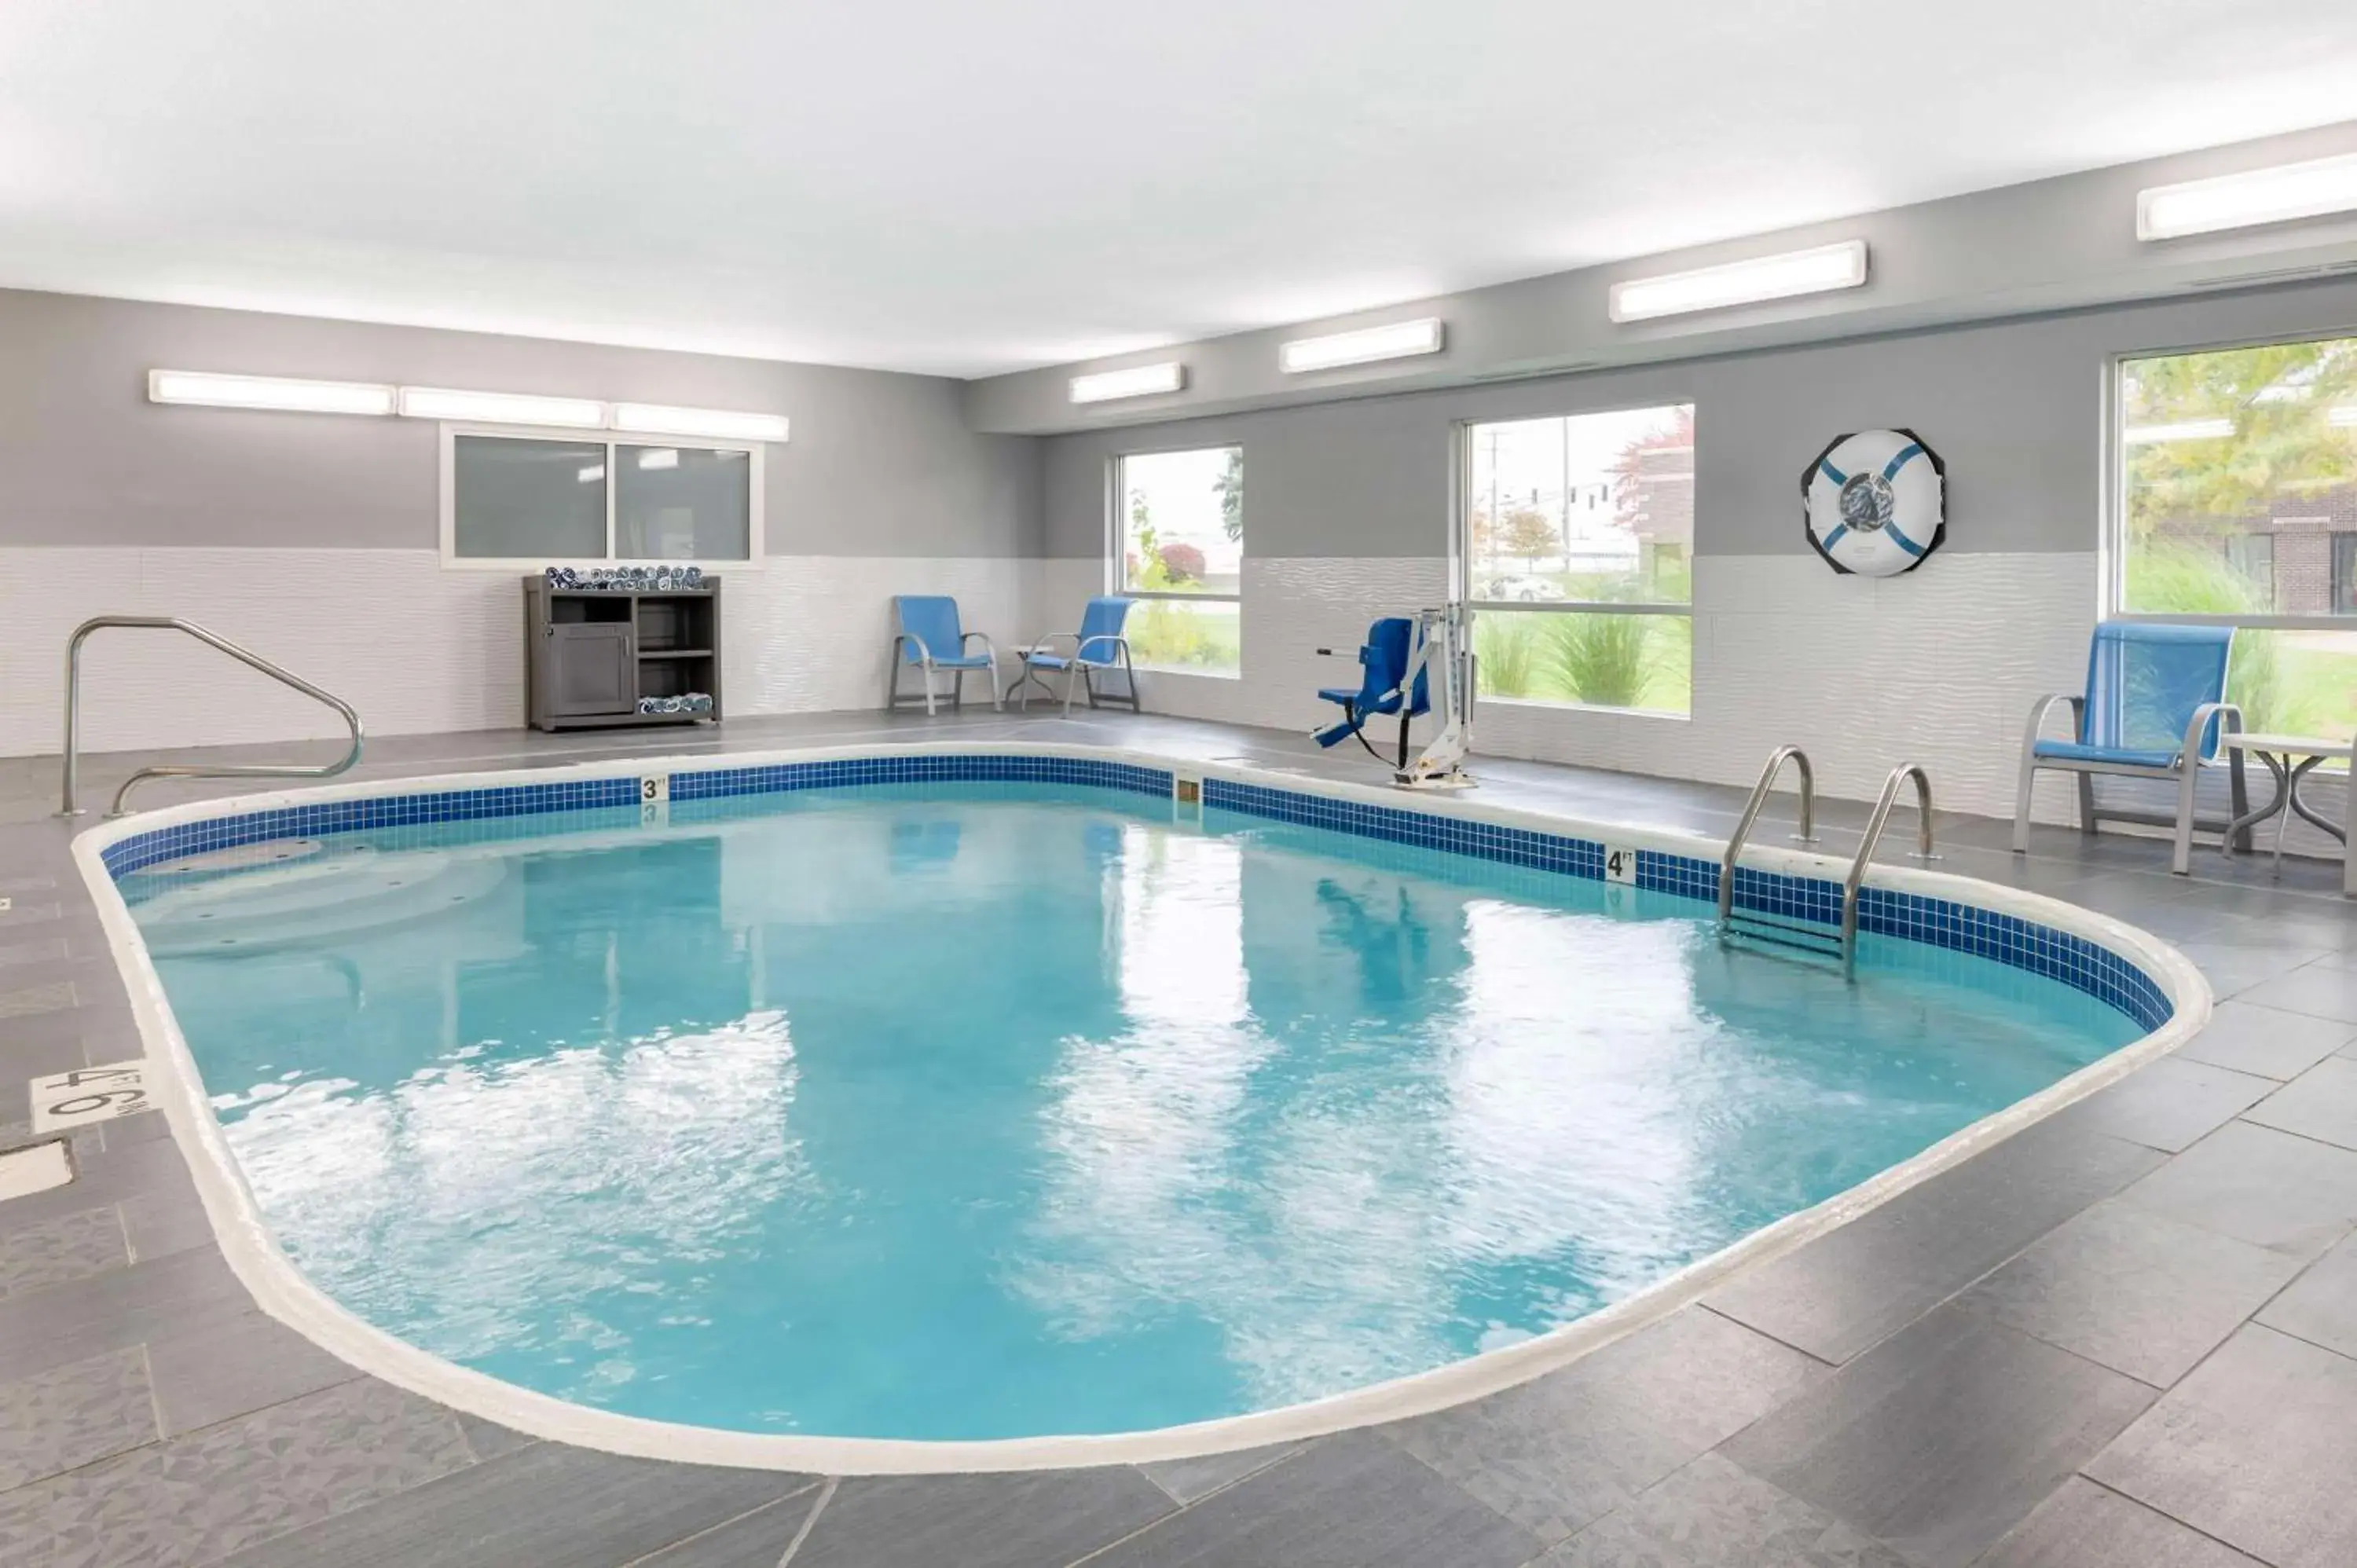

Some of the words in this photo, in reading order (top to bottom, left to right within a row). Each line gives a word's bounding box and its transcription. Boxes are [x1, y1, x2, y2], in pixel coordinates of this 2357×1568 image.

[643, 780, 656, 799] 3
[1607, 851, 1622, 877] 4
[1622, 852, 1633, 862] FT
[46, 1069, 140, 1090] 4
